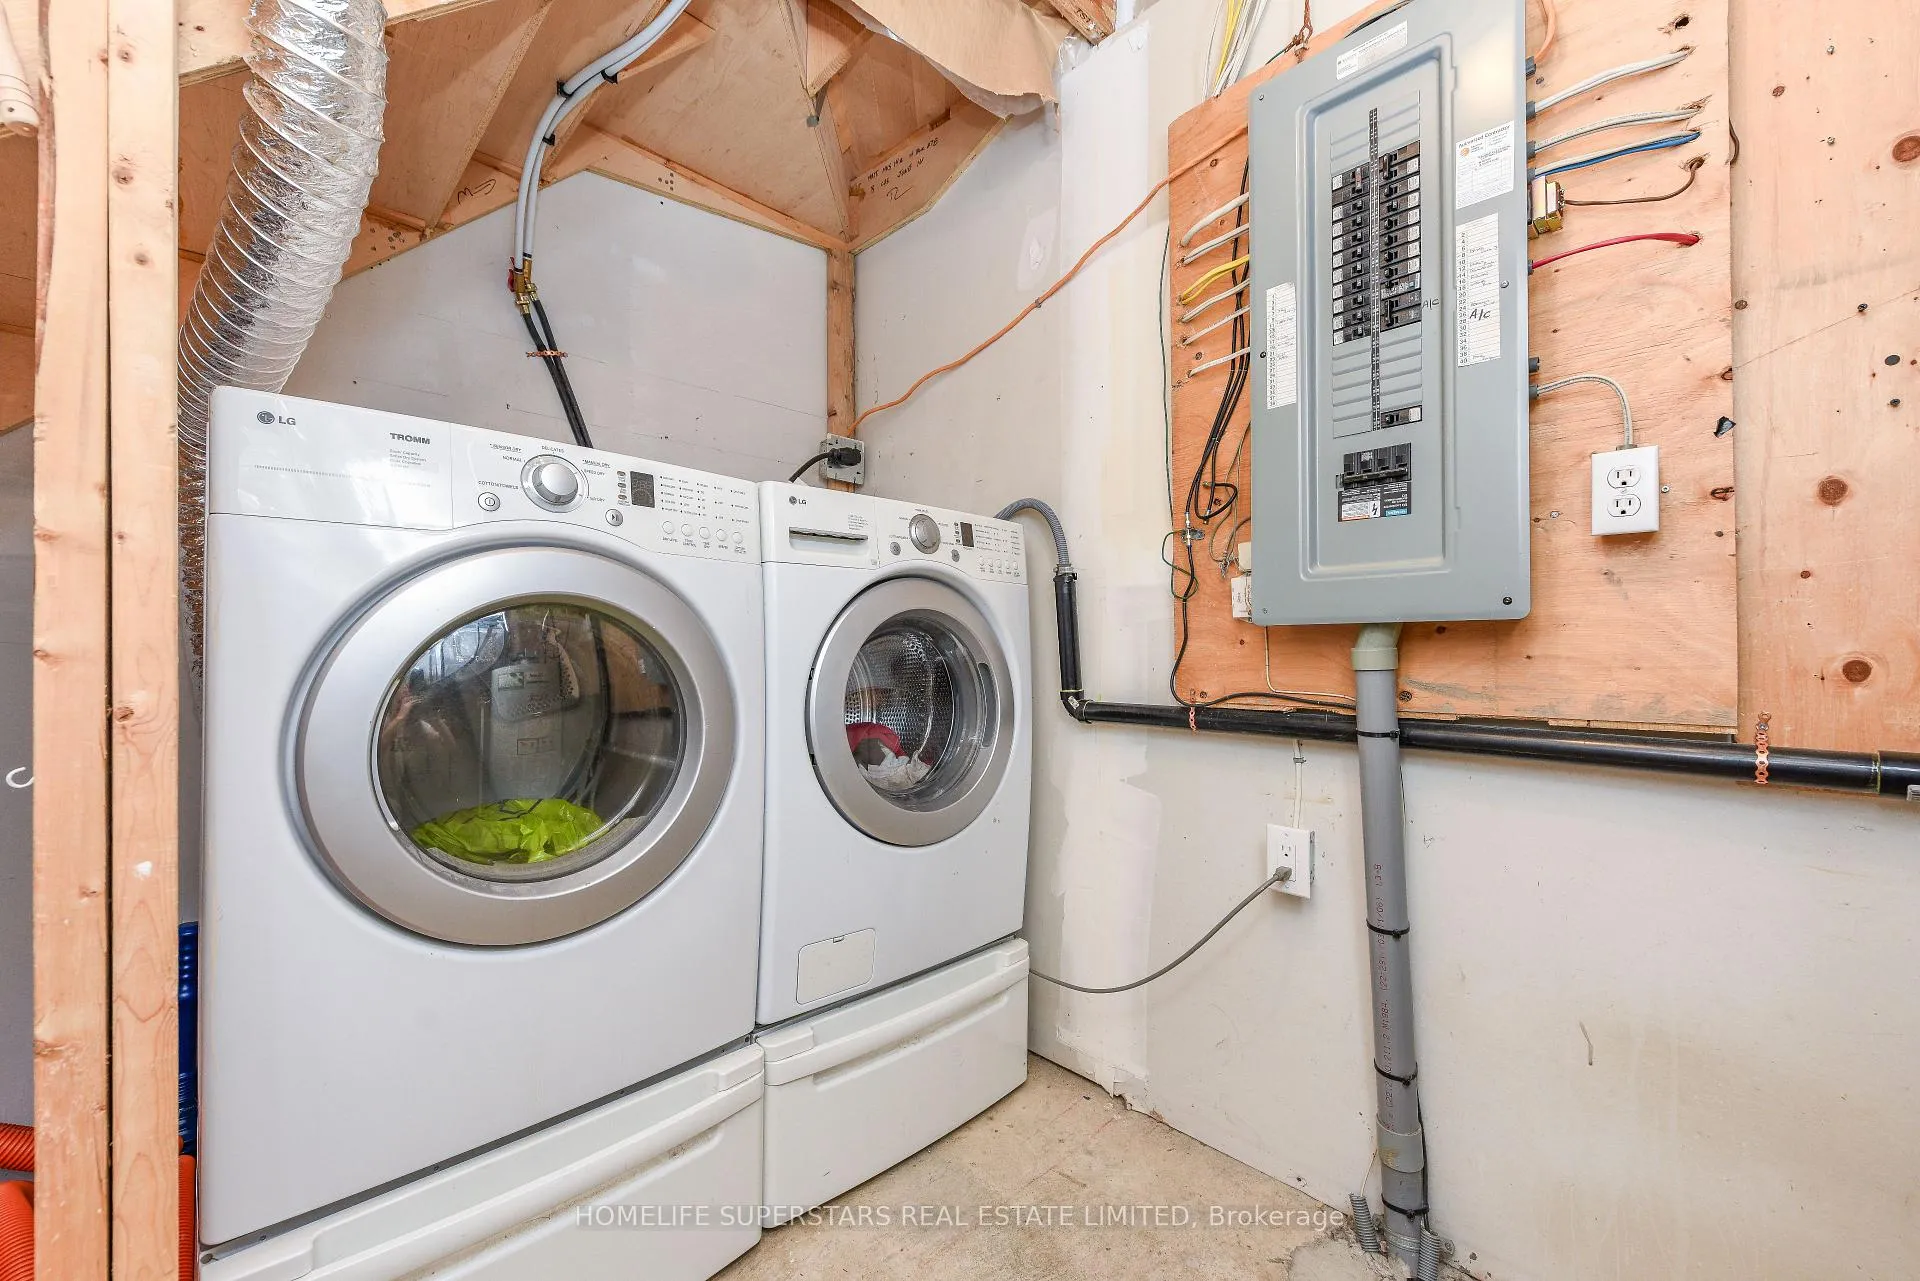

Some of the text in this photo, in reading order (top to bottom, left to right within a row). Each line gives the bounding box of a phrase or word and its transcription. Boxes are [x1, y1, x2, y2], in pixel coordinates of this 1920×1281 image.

[1470, 308, 1491, 320] A/C
[278, 415, 296, 426] LG
[389, 432, 431, 445] TROMM
